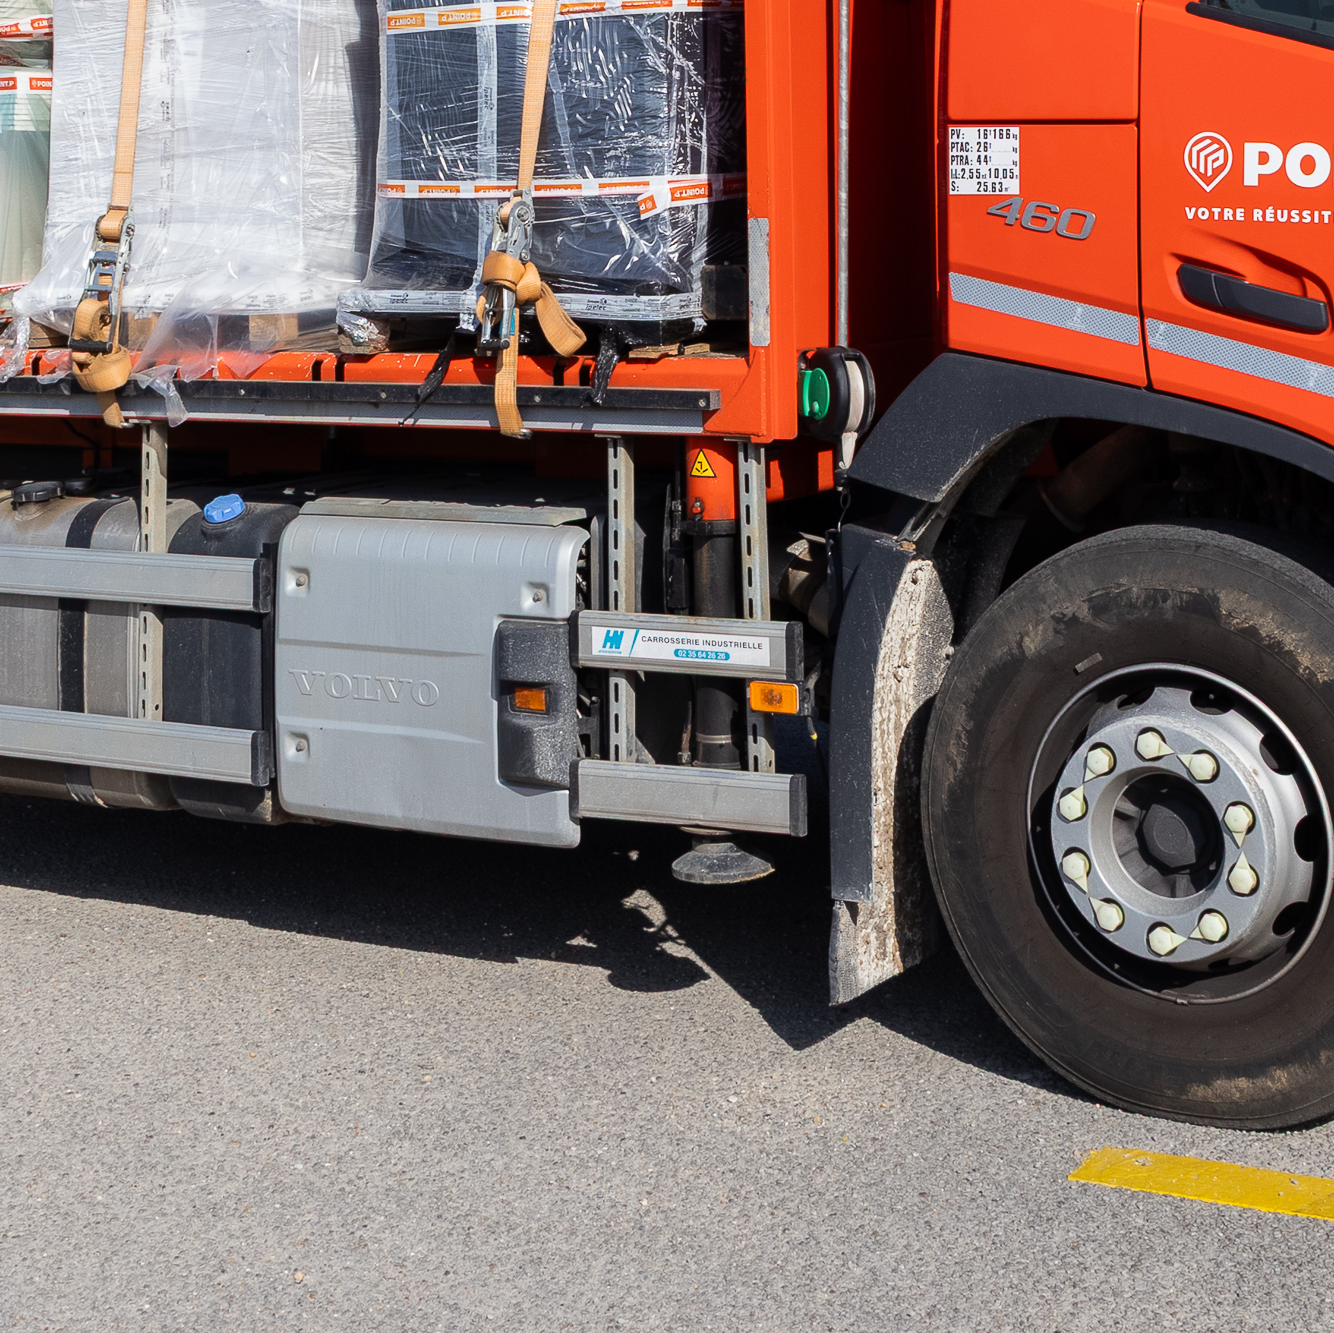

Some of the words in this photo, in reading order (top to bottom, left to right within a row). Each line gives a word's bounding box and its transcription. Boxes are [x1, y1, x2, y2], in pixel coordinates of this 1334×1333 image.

[950, 128, 964, 139] PV:
[950, 141, 973, 152] PTAC:
[950, 154, 973, 165] PTRA:
[951, 181, 960, 192] S:
[987, 197, 1096, 240] 460
[1184, 206, 1245, 221] VOTRE
[641, 635, 700, 646] CARROSSERIE
[702, 639, 763, 650] INDUSTRIELLE
[288, 668, 440, 707] VOLVO
